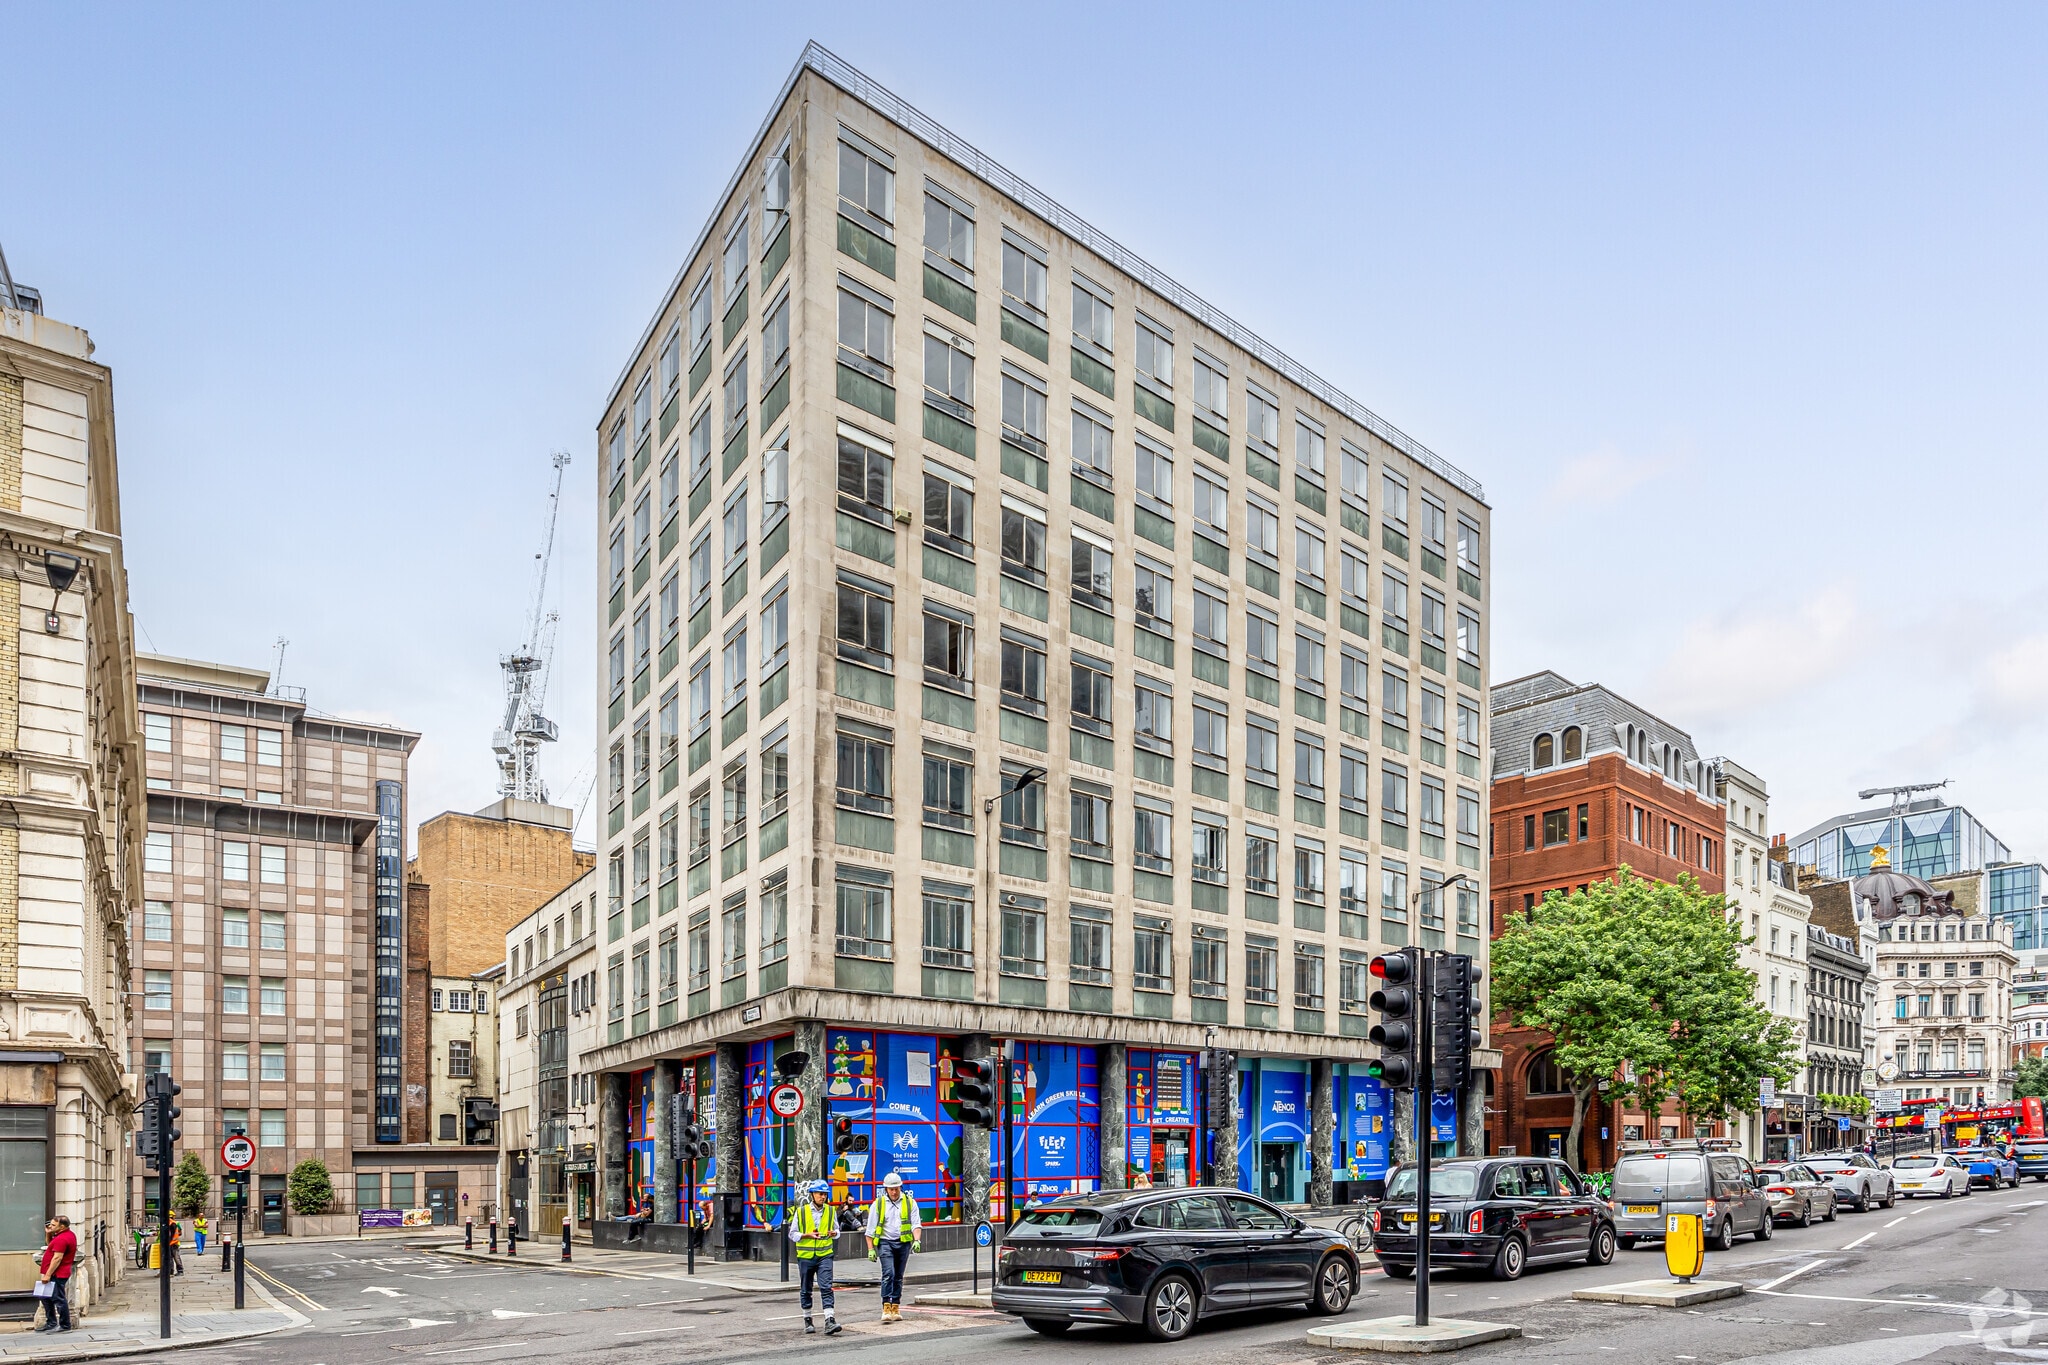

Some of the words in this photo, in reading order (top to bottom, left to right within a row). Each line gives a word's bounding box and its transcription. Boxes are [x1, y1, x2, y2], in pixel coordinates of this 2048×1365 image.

[889, 1103, 911, 1111] COME
[912, 1106, 922, 1115] IN,
[1027, 1102, 1045, 1120] LEARN
[1045, 1091, 1065, 1104] GREEN
[1271, 1100, 1296, 1114] ATENOR
[1165, 1116, 1190, 1124] CREATIVE
[1038, 1183, 1059, 1193] ATENOR
[1027, 1271, 1044, 1281] OE72
[1046, 1271, 1060, 1281] PYW
